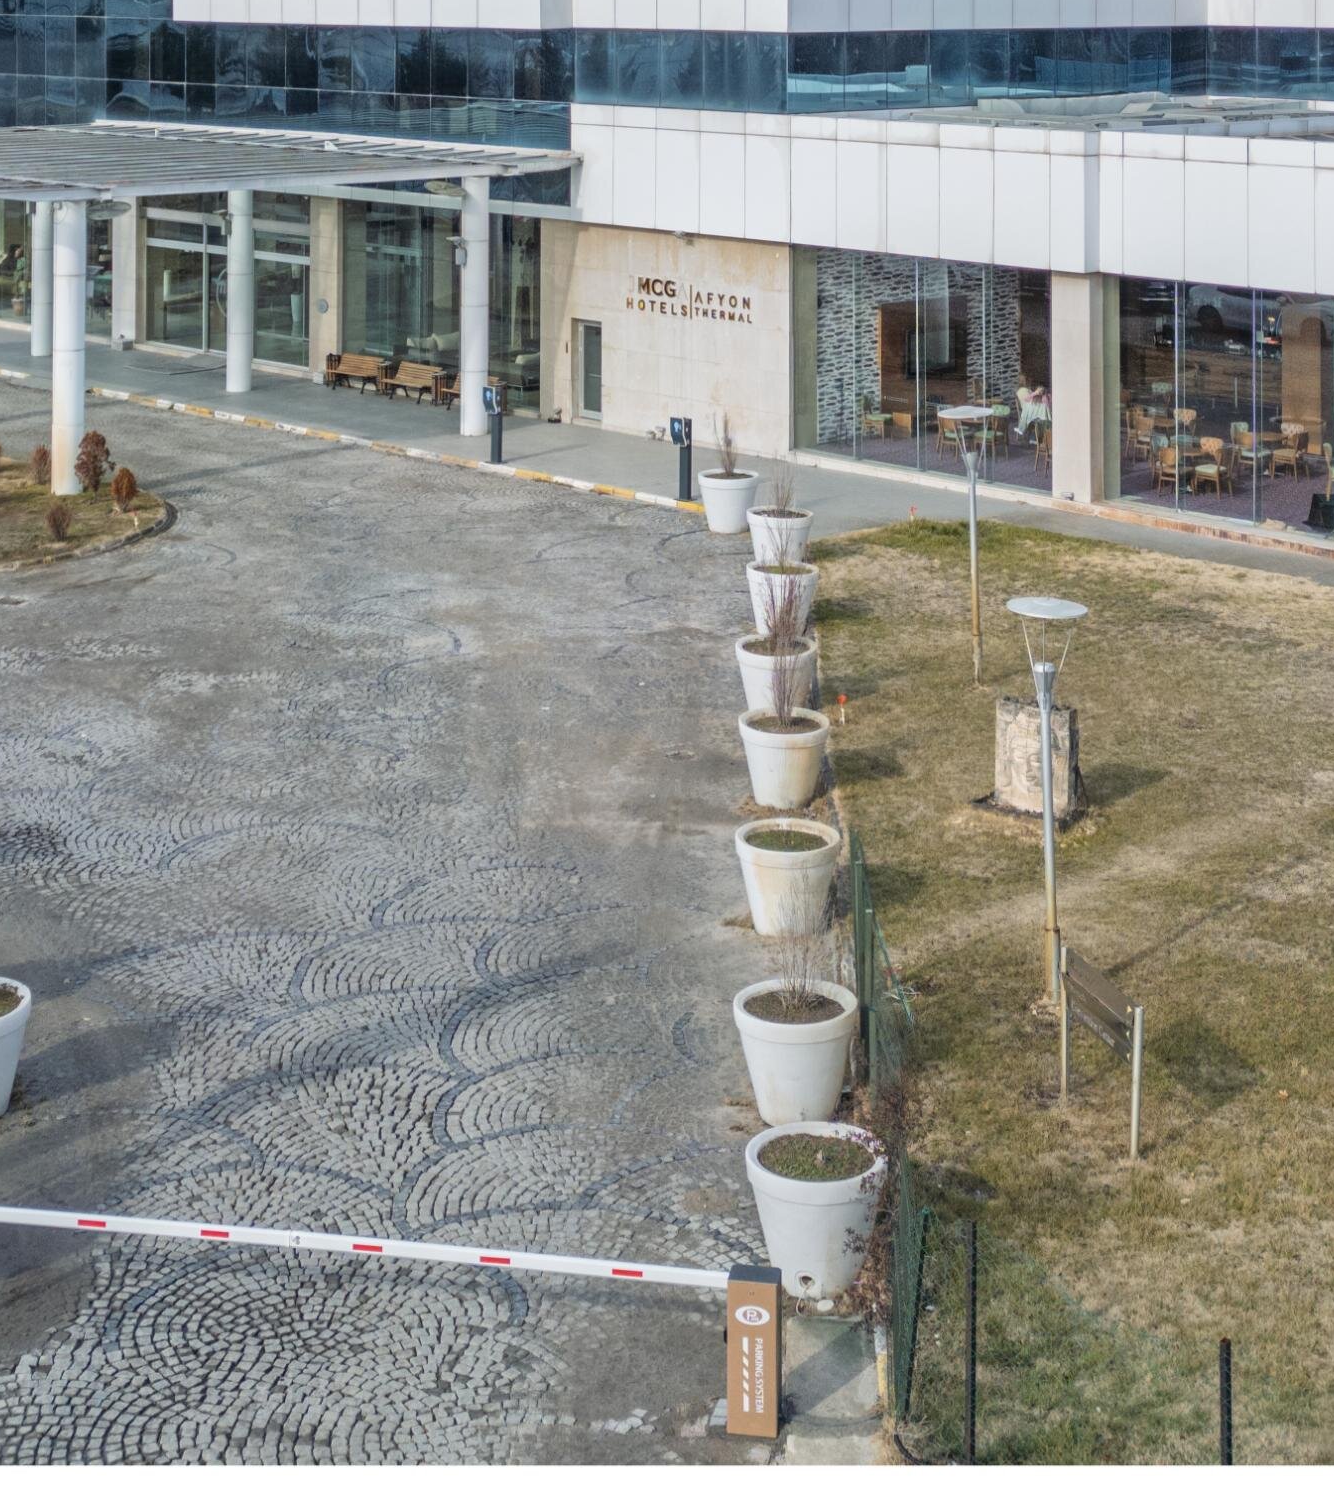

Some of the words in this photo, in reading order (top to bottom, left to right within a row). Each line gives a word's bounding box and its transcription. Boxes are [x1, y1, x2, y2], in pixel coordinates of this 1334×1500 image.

[626, 297, 687, 317] HOTELS
[695, 307, 752, 324] THERMAL
[637, 276, 676, 298] MCG
[694, 291, 751, 310] AFYON
[754, 1338, 763, 1376] PARKING
[754, 1377, 764, 1413] SYSTEM
